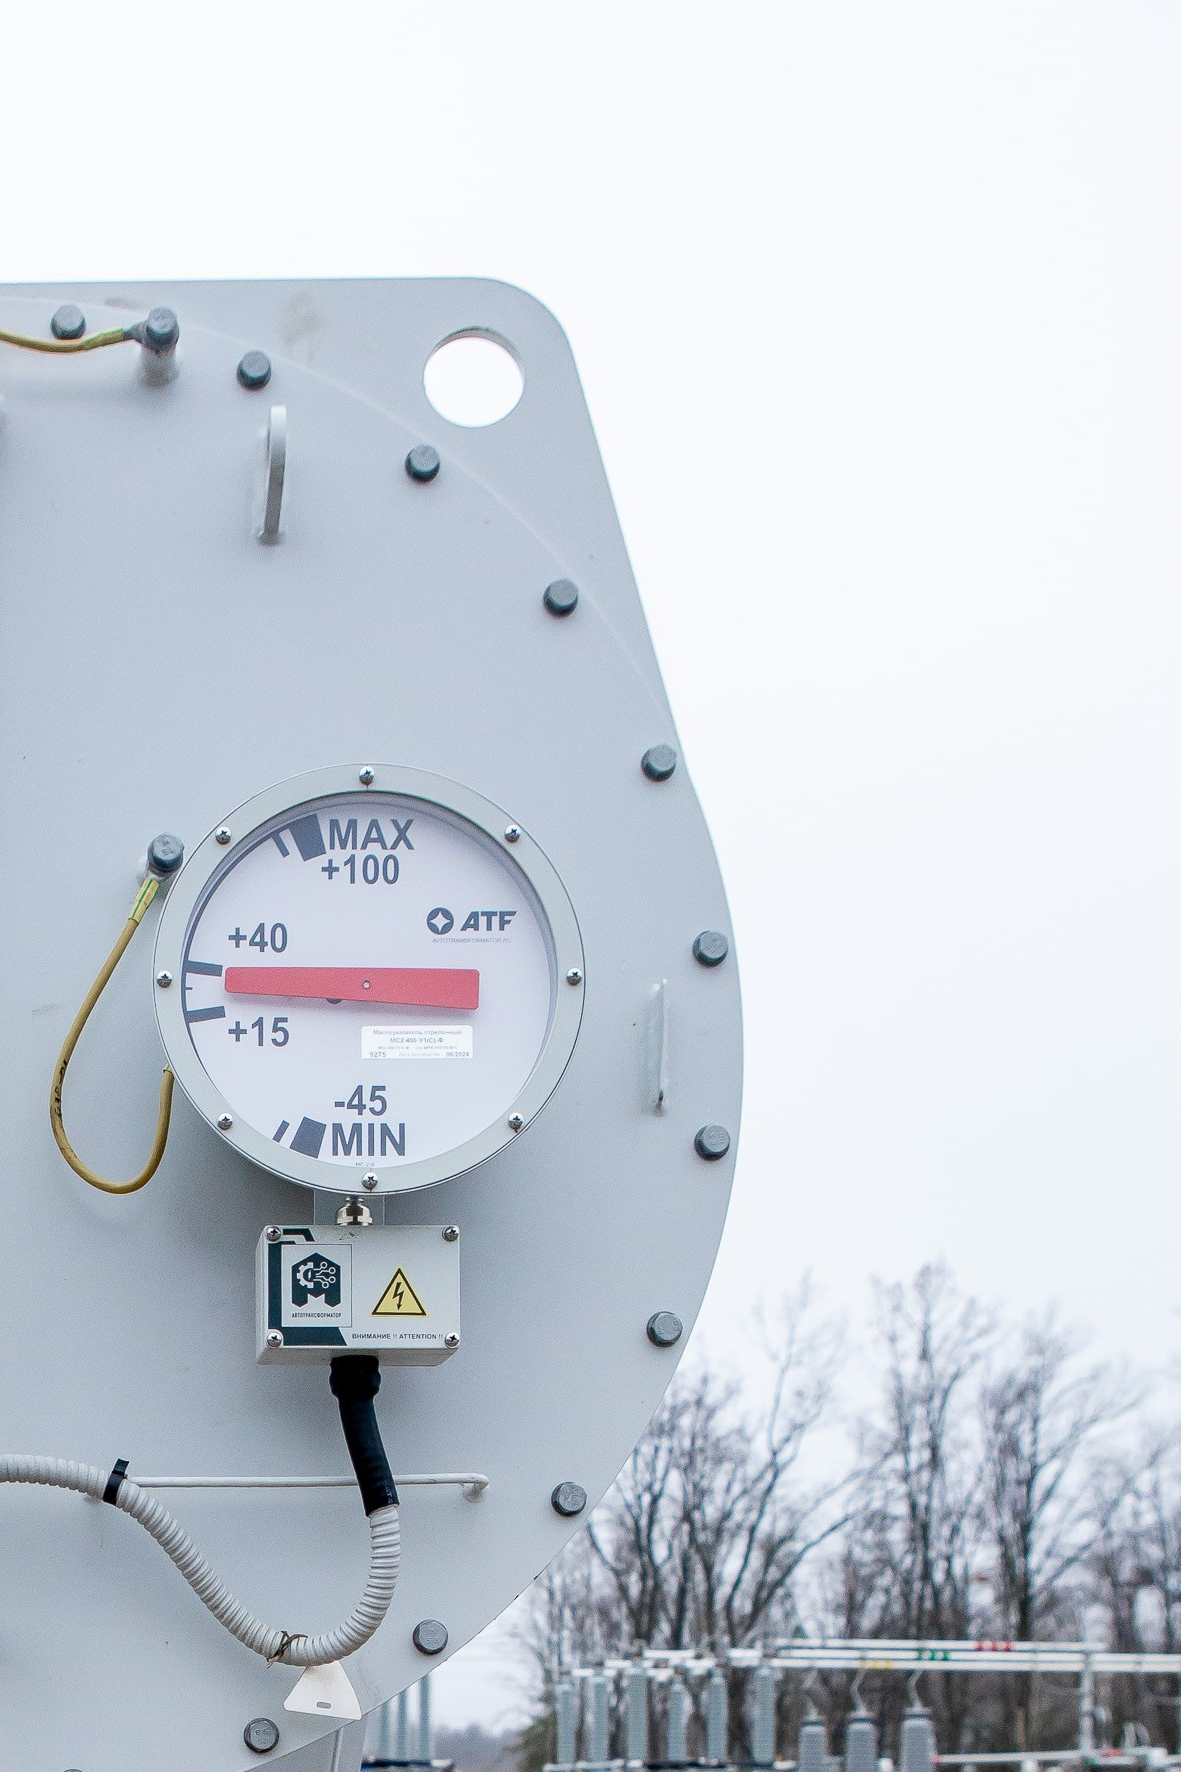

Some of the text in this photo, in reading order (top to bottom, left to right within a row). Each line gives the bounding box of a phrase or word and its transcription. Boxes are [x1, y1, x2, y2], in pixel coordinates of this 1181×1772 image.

[329, 818, 415, 850] MAX
[321, 853, 399, 885] +100
[460, 910, 517, 931] ATF
[227, 922, 287, 953] +40
[227, 1016, 289, 1047] +15
[334, 1085, 387, 1116] -45
[332, 1122, 405, 1156] MIN
